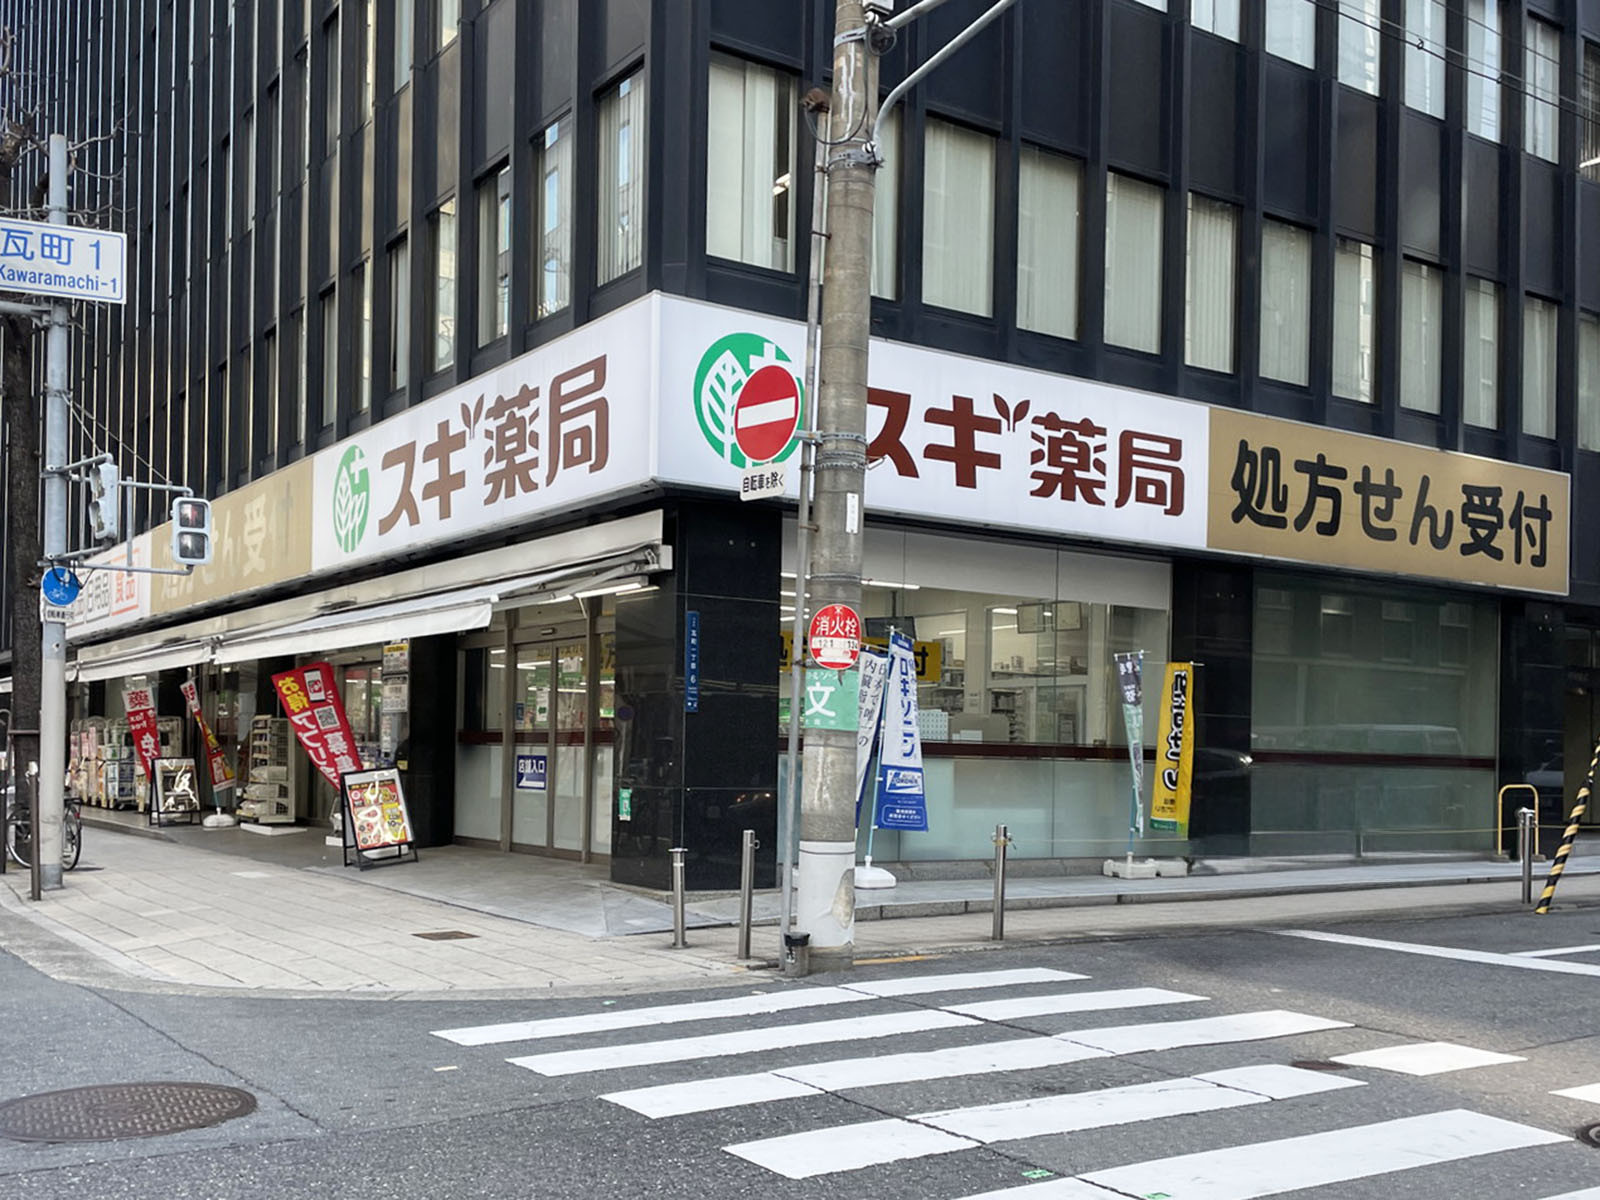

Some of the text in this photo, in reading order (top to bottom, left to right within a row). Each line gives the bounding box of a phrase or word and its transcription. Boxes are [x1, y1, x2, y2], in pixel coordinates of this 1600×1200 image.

[0, 227, 102, 271] 瓦町 1
[0, 263, 118, 294] Kawaramachi-1
[378, 353, 610, 537] スギ薬局
[866, 387, 1186, 517] スギ薬局
[742, 471, 785, 493] 自転車を除く
[1230, 438, 1553, 569] 処方せん受付
[815, 616, 857, 638] 消火栓
[805, 681, 837, 717] 文
[899, 656, 916, 758] ロキソニン
